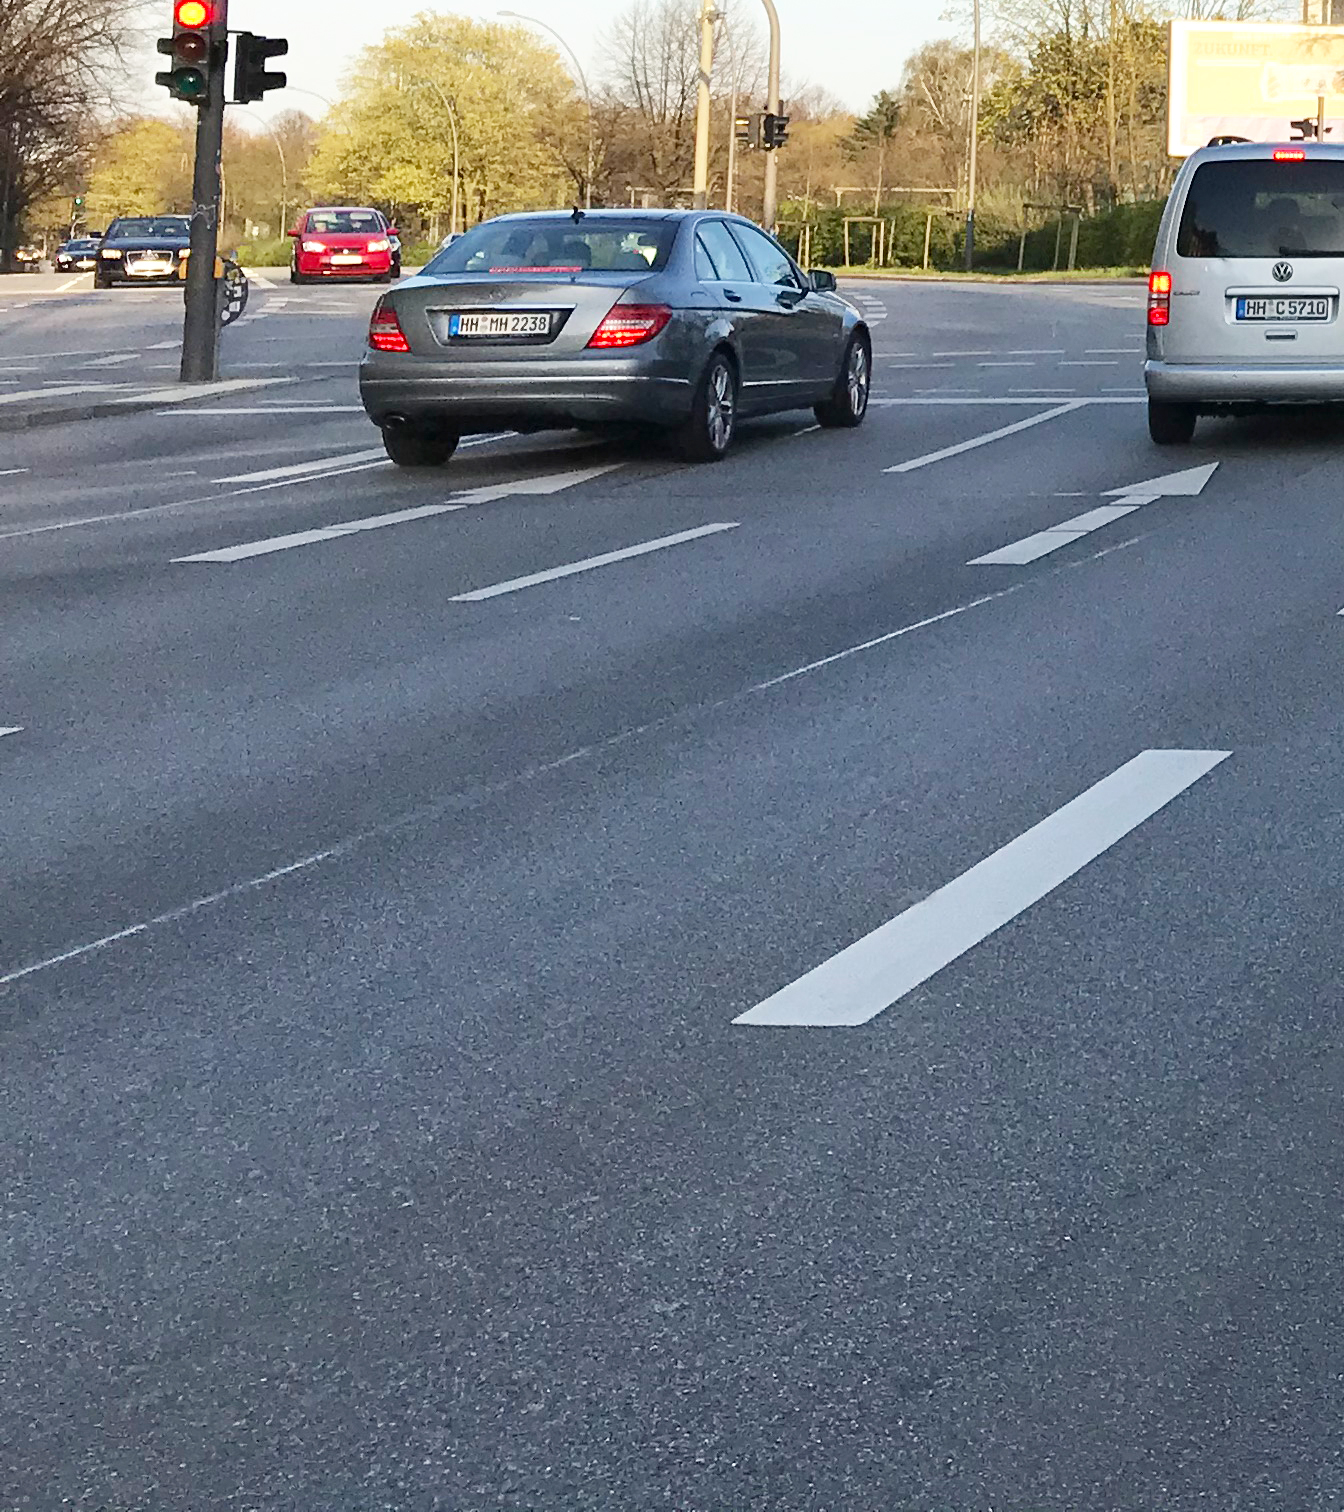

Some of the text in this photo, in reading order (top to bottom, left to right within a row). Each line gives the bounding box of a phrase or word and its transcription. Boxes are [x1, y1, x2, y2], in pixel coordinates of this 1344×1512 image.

[1246, 301, 1325, 316] HH C 5710
[460, 316, 547, 332] HH MH 2238
